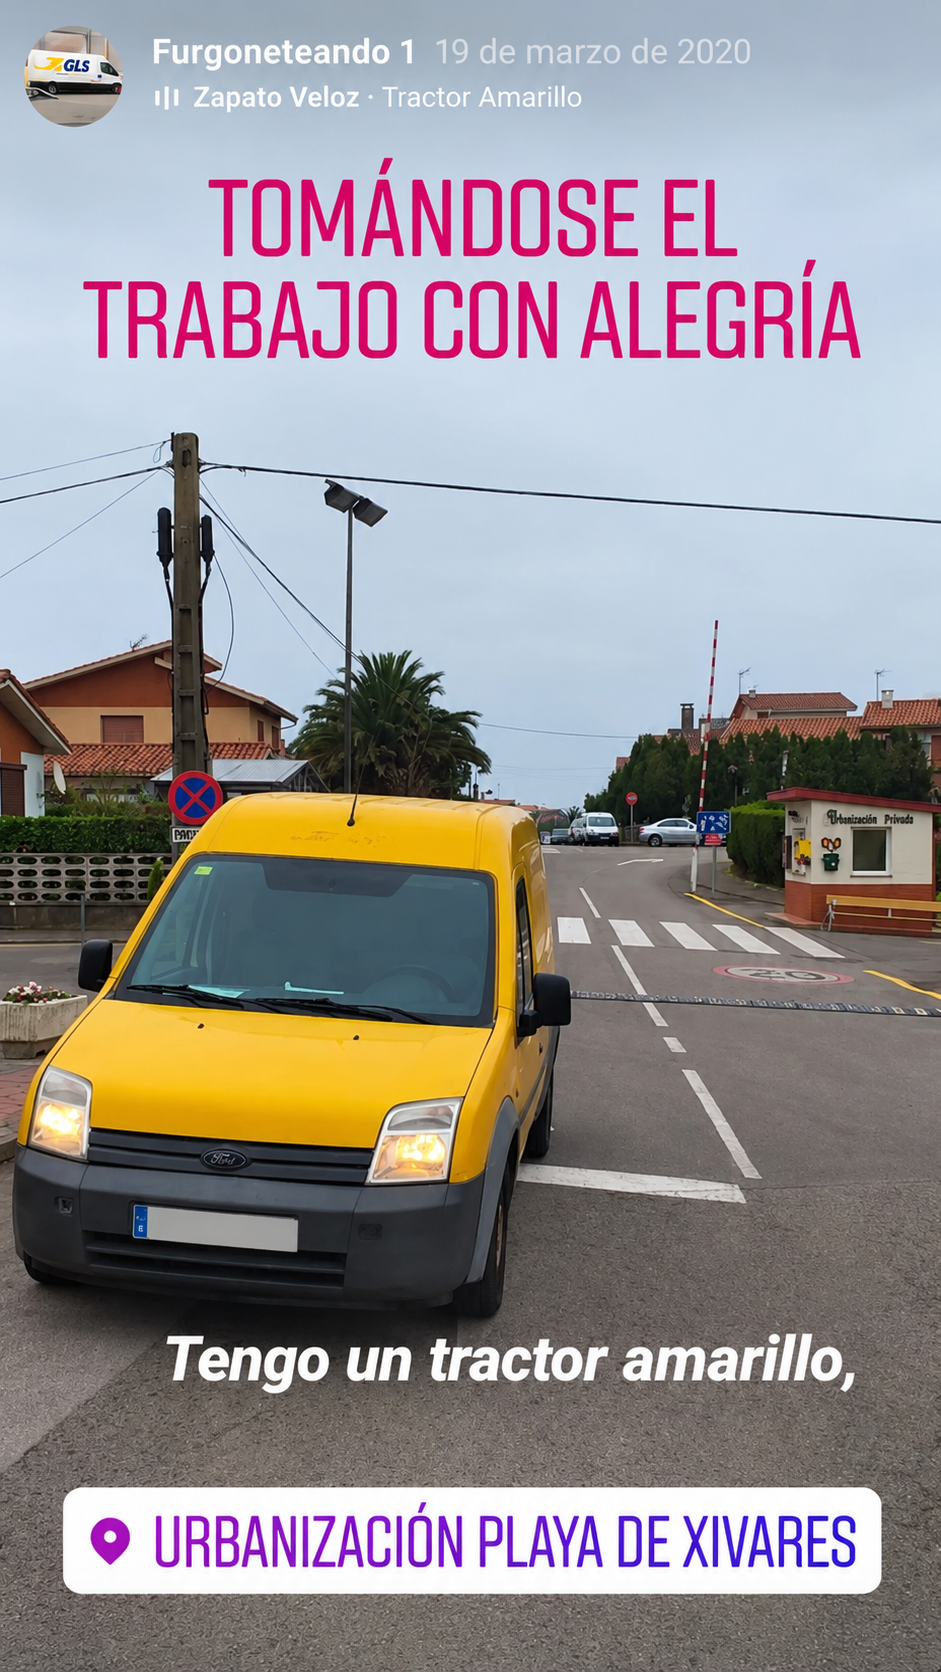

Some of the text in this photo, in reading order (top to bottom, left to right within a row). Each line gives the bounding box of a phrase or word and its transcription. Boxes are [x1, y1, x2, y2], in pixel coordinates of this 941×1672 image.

[826, 809, 914, 825] Urbanización Privada
[210, 1151, 236, 1166] Ford
